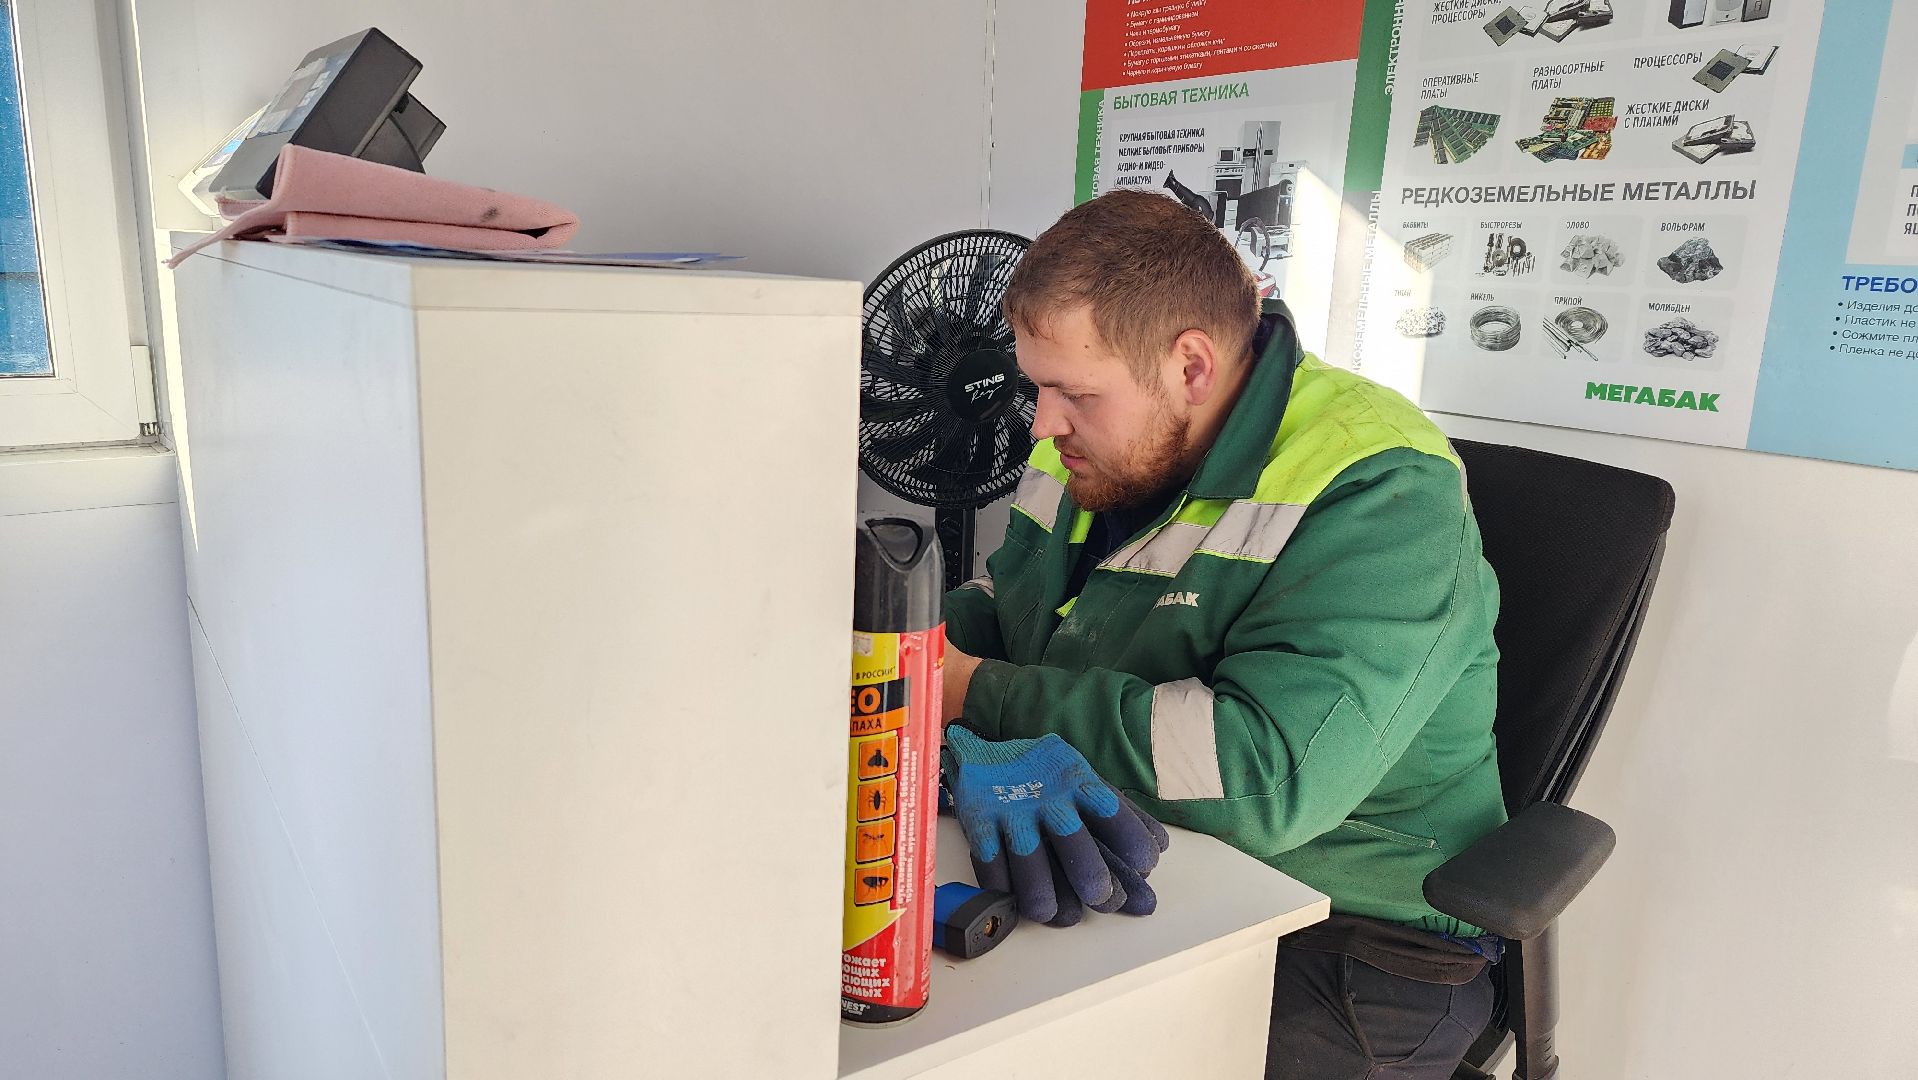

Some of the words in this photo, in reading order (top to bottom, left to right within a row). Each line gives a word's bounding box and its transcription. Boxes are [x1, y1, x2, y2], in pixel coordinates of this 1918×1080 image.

[1432, 0, 1469, 12] ЖЕСТКИЕ
[1431, 8, 1486, 24] ПРОЦЕССОРЫ
[1634, 52, 1702, 68] ПРОЦЕССОРЫ
[1533, 60, 1606, 78] РАЗНОСОРТНЫЕ
[1422, 72, 1480, 88] ОПЕРАТИВНЫЕ
[1532, 78, 1562, 90] ПЛАТЫ
[1113, 90, 1178, 110] БЫТОВАЯ
[1181, 82, 1250, 104] ТЕХНИКА
[1420, 88, 1448, 100] ПЛАТЫ
[1626, 101, 1672, 116] ЖЕСТКИЕ
[1673, 98, 1710, 114] ДИСКИ
[1624, 116, 1630, 128] С
[1632, 114, 1679, 128] ПЛАТАМИ
[1120, 131, 1147, 142] КРУПНАЯ
[1146, 129, 1176, 141] БЫТОВАЯ
[1176, 128, 1205, 140] ТЕХНИКА
[1118, 147, 1142, 158] МЕЛКИЕ
[1142, 145, 1172, 156] БЫТОВЫЕ
[1173, 142, 1205, 154] ПРИБОРЫ
[1117, 161, 1138, 172] АУДИО-
[1139, 162, 1144, 170] И
[1144, 160, 1166, 171] ВИДЕО-
[1116, 175, 1152, 186] АППАРАТУРА
[1402, 183, 1616, 208] РЕДКОЗЕМЕЛЬНЫЕ
[1622, 180, 1756, 201] МЕТАЛЛЫ
[1402, 221, 1429, 229] БАББИТЫ
[1480, 221, 1522, 230] БЫСТРОРЕЗЫ
[1566, 221, 1590, 230] ОЛОВО
[1660, 222, 1706, 232] ВОЛЬФРАМ
[1842, 275, 1918, 294] ТРЕБО
[1470, 292, 1494, 302] НИКЕЛЬ
[1554, 296, 1582, 306] ПРИПОЙ
[1648, 302, 1690, 314] МОЛИБДЕН
[1847, 300, 1900, 312] Изделия
[1844, 314, 1896, 327] Пластик
[1900, 319, 1916, 328] не
[1842, 329, 1900, 342] Сожмите
[1839, 344, 1884, 356] Пленка
[1888, 348, 1904, 358] не
[964, 373, 1004, 392] STING
[1584, 382, 1720, 412] МЕГАБАК
[851, 718, 882, 732] ПАХА
[842, 953, 886, 968] ожает
